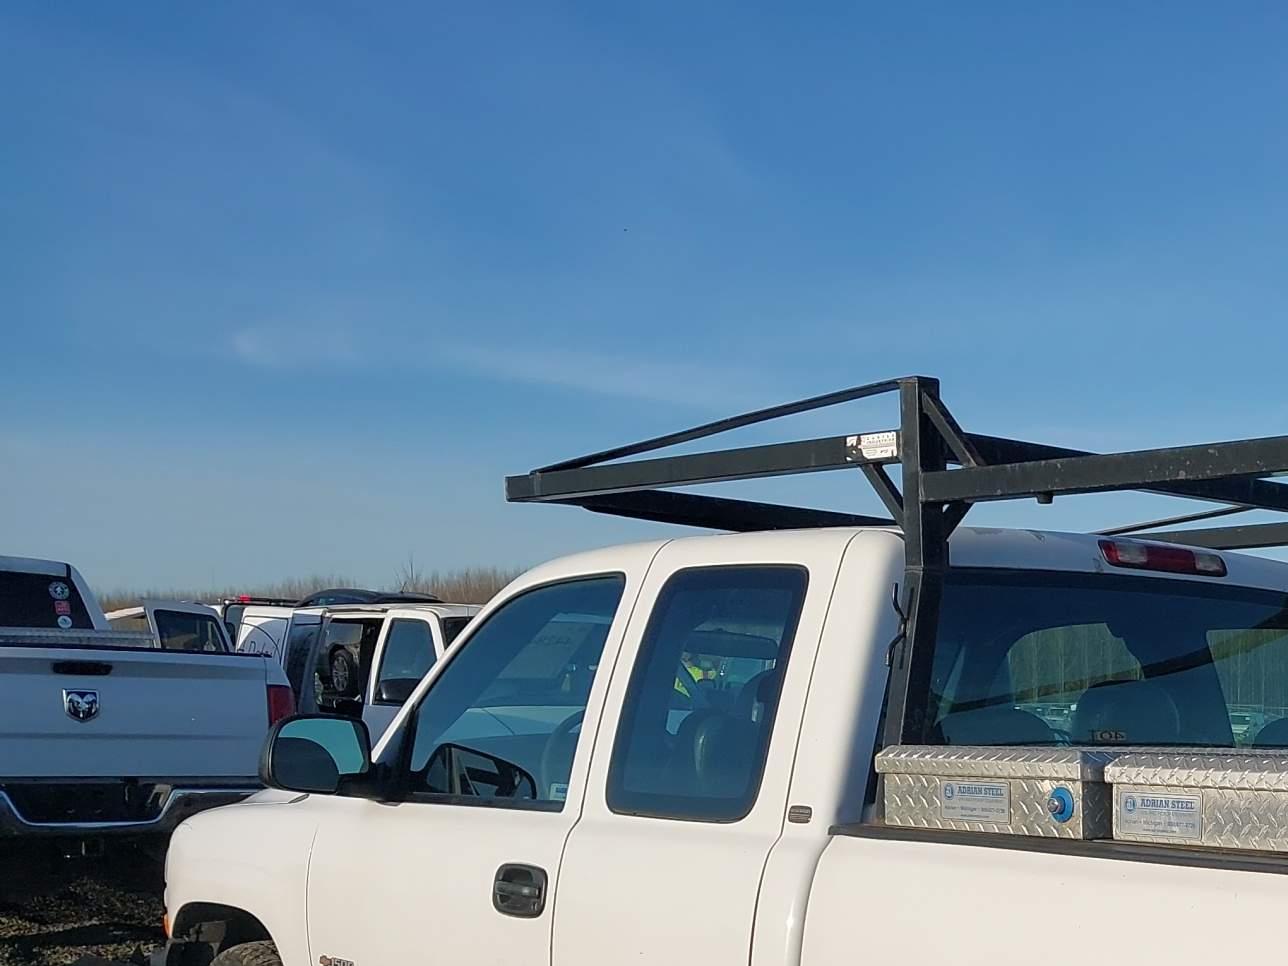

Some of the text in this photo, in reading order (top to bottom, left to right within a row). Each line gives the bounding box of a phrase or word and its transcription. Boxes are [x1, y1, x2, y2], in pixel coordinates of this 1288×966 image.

[957, 785, 1004, 797] ADRIAN STEEL
[1140, 798, 1196, 810] ADRIAN STEEL
